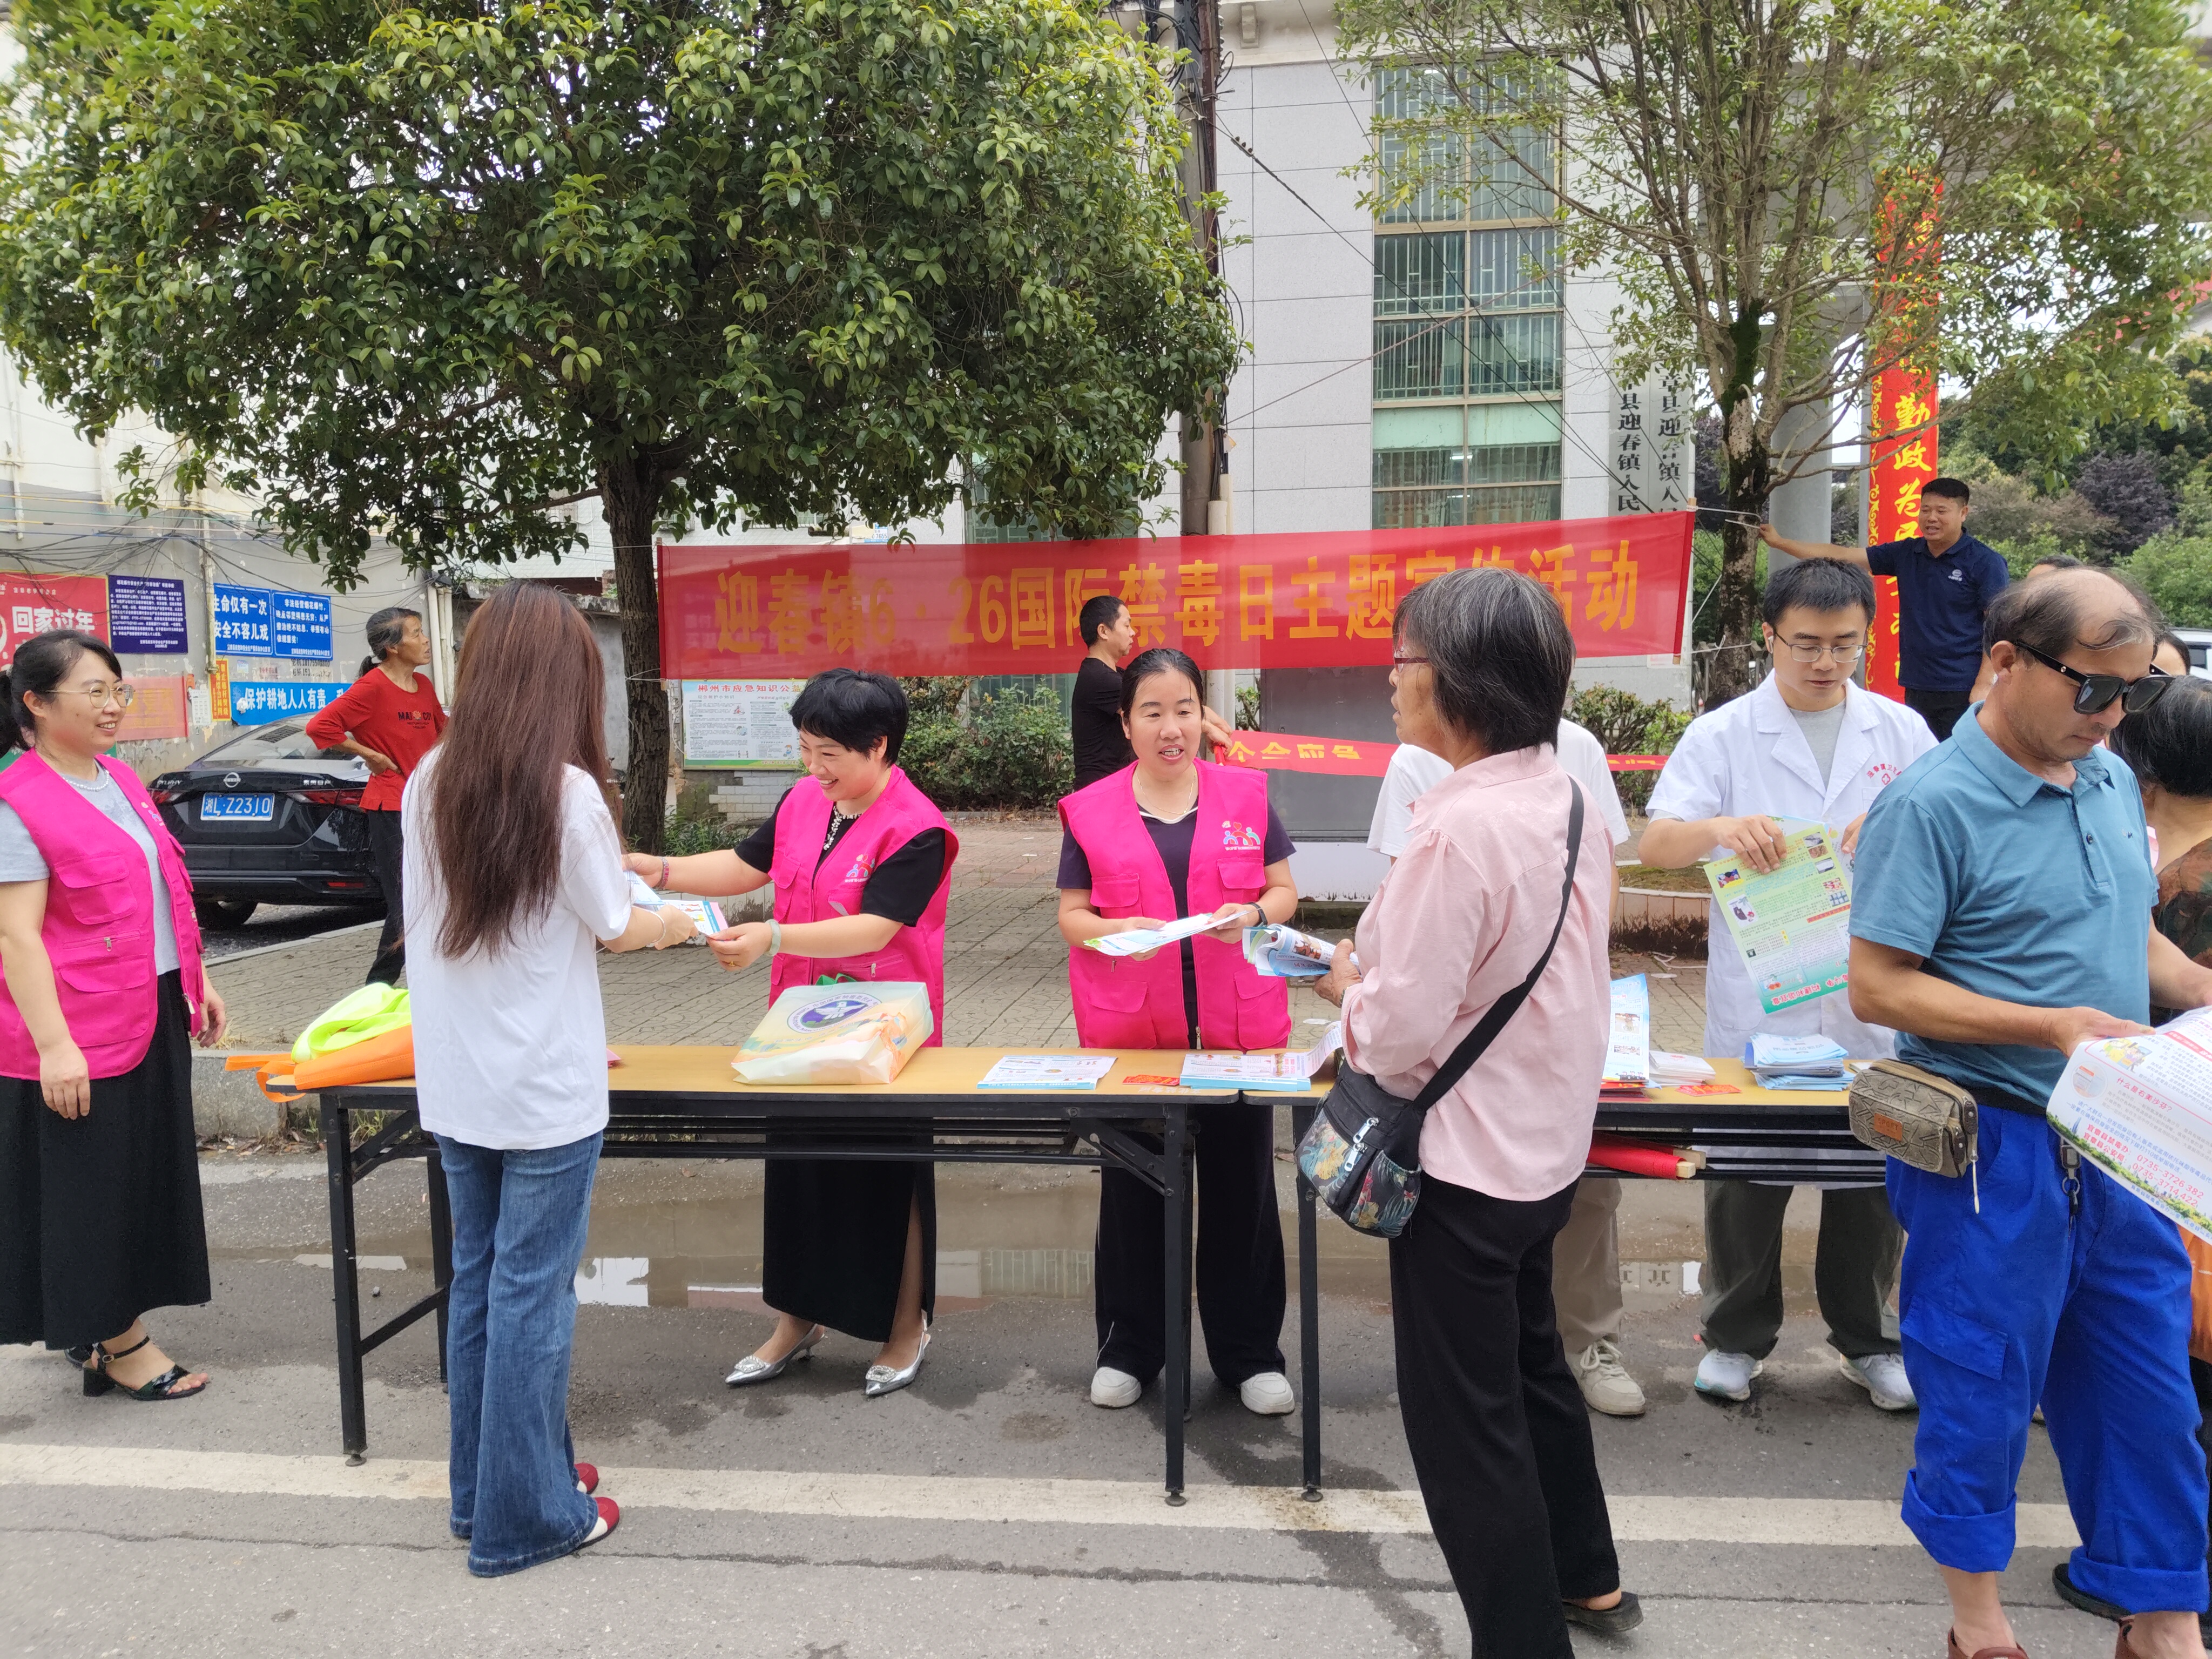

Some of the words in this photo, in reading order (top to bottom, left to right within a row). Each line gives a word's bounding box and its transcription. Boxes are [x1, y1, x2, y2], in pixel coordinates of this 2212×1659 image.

[1617, 383, 1642, 511] 县迎春镇人民
[214, 594, 267, 615] 生命仅有一次
[716, 540, 1638, 655] 迎春镇6·26国际禁毒日主题活动
[12, 606, 96, 635] 回家过年
[214, 620, 269, 641] 安全不容儿戏
